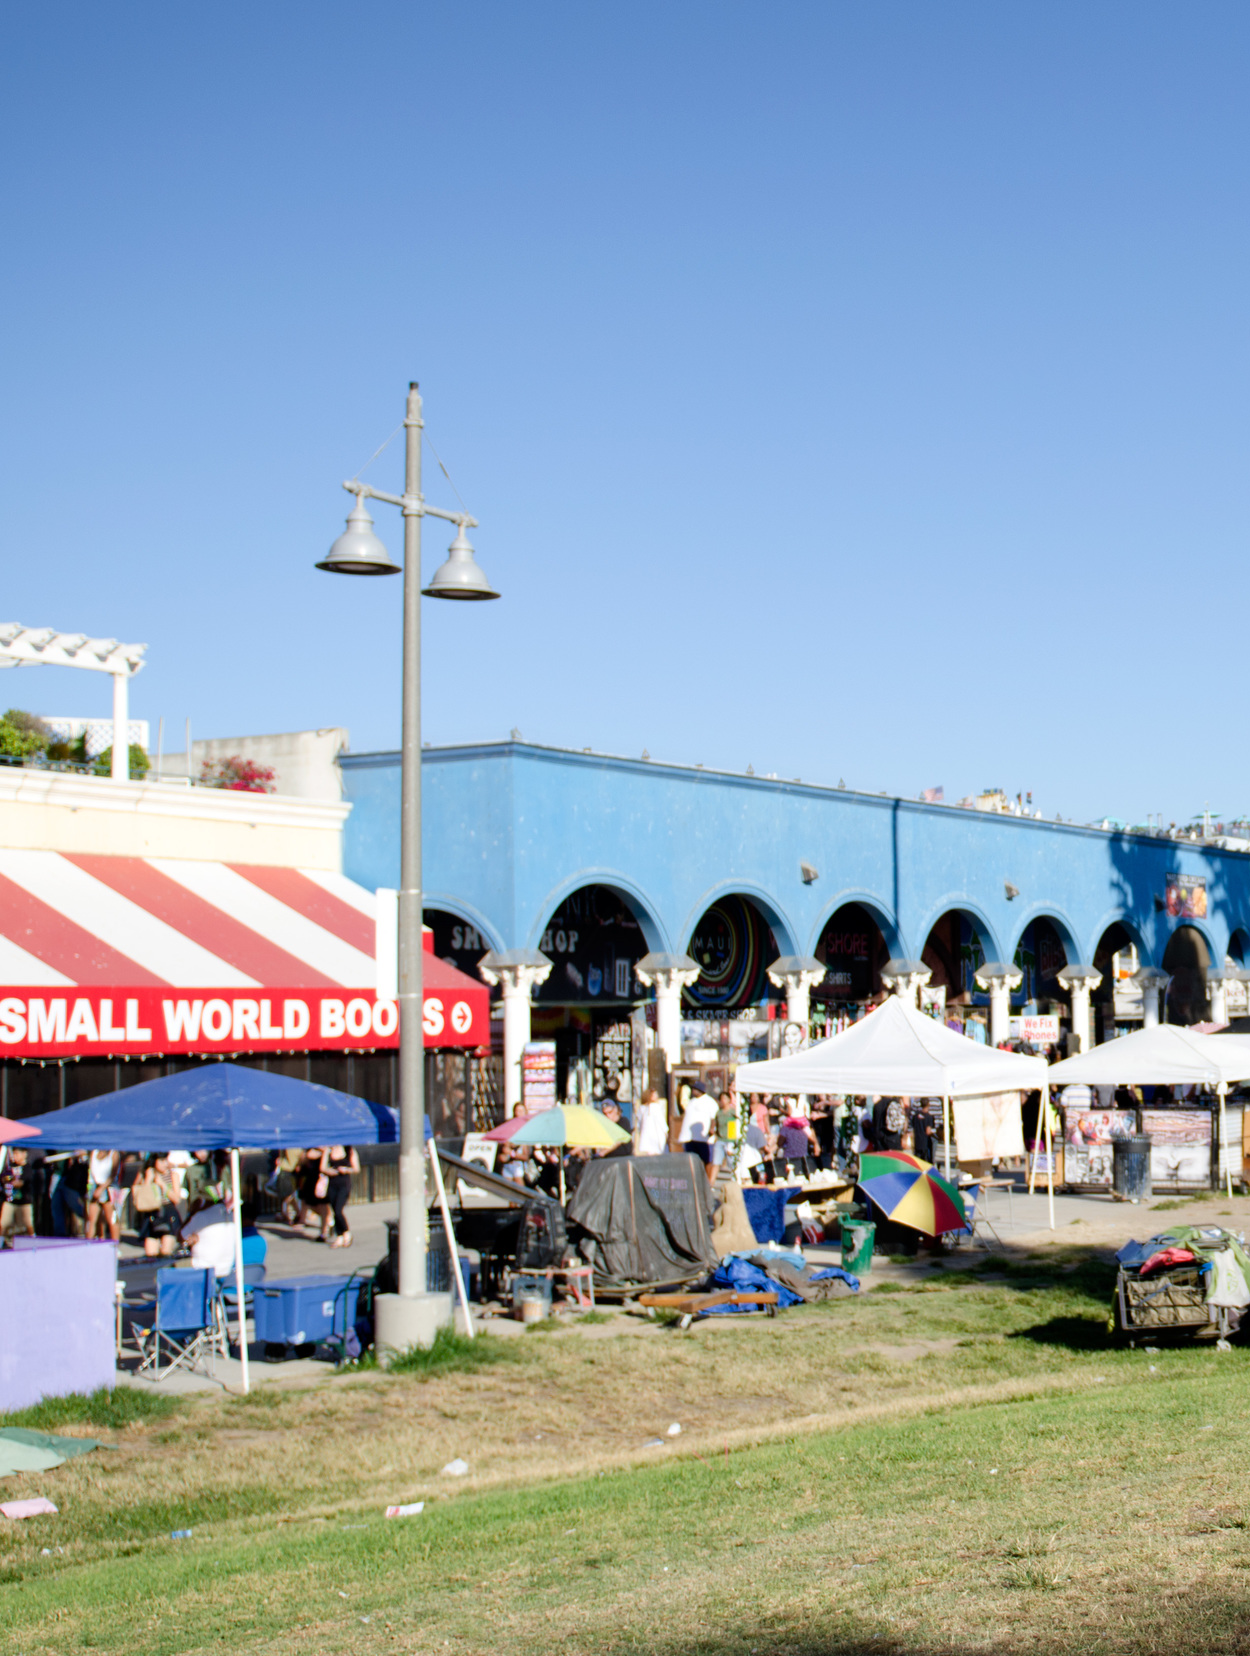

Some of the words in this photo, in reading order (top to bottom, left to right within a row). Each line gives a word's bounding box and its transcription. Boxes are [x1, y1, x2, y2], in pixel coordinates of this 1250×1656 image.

[540, 929, 579, 953] HOP
[695, 936, 731, 950] MAUI
[827, 932, 868, 955] SHORE
[0, 998, 152, 1044] SMALL
[162, 998, 310, 1042] WORLD
[320, 997, 445, 1038] BOOS
[1024, 1018, 1038, 1029] We
[1039, 1017, 1053, 1028] Fix
[468, 1143, 493, 1152] OPEN
